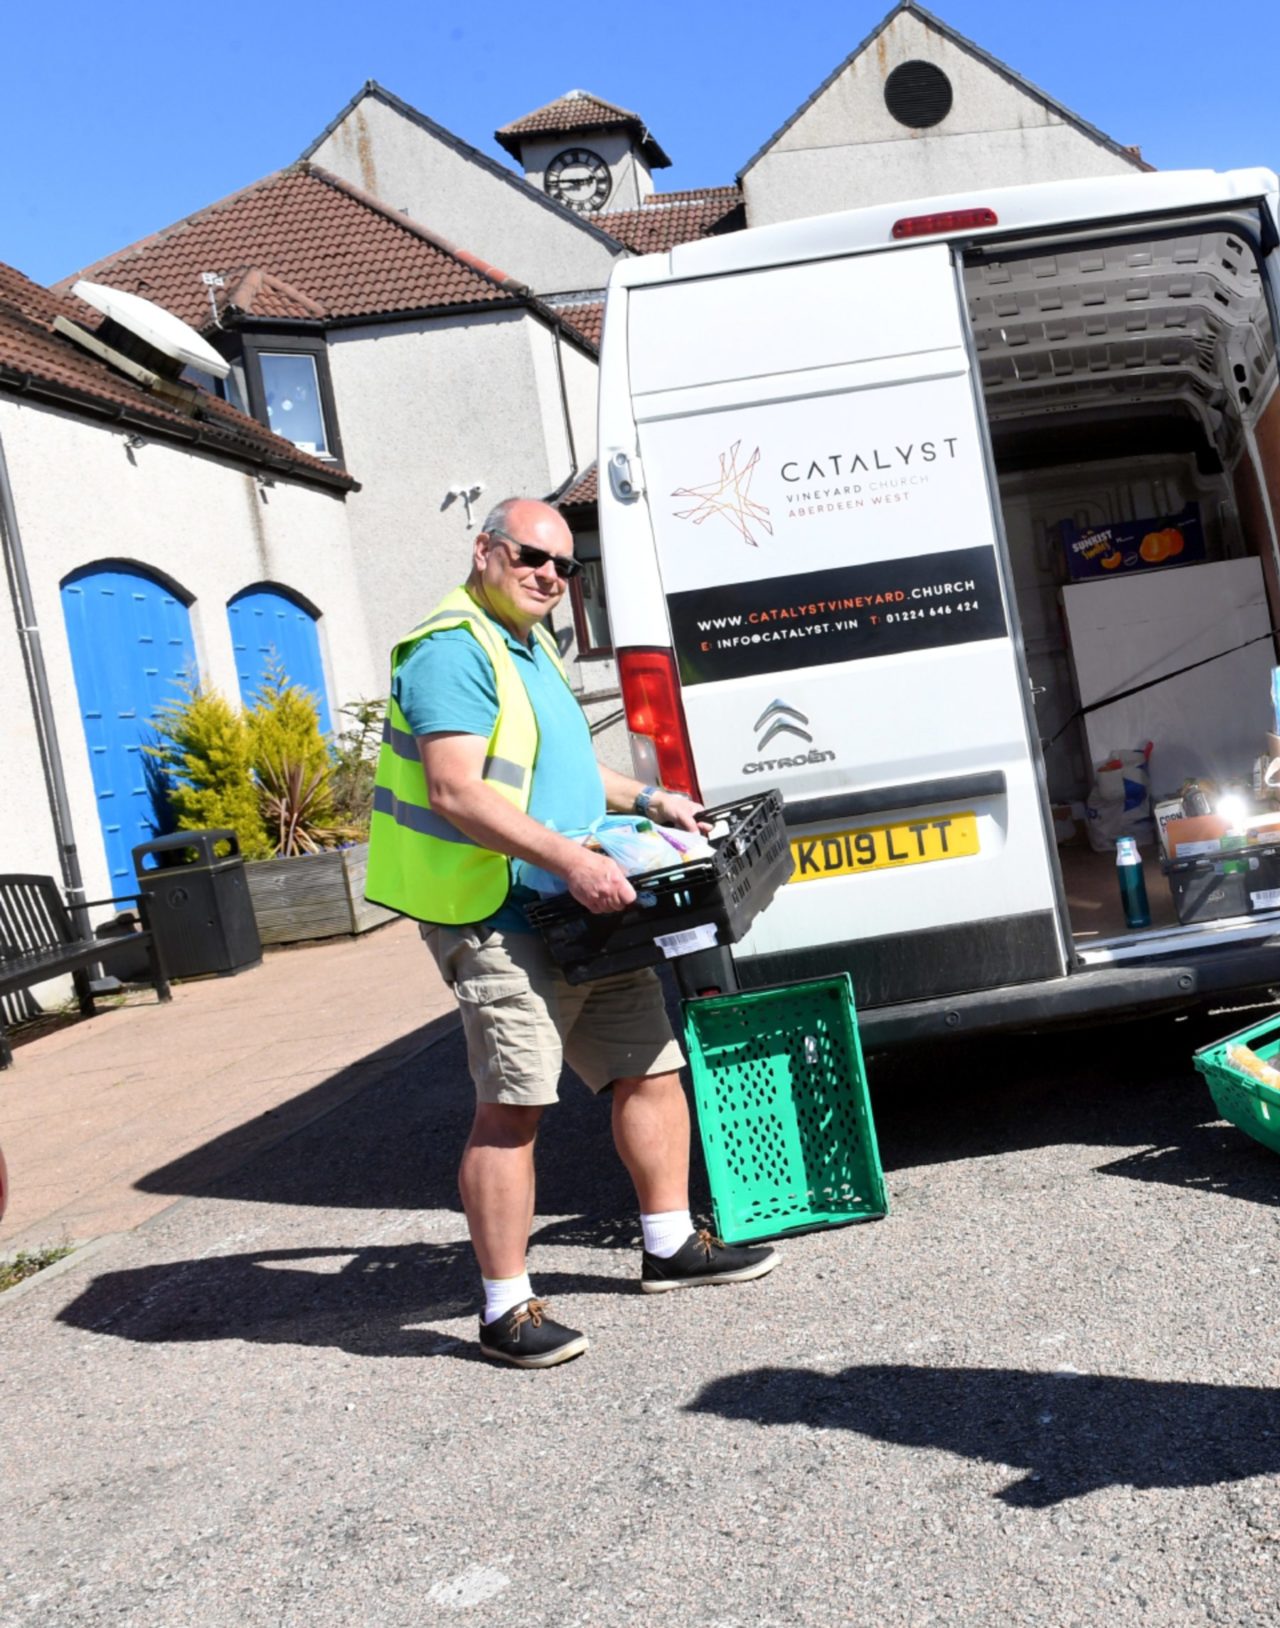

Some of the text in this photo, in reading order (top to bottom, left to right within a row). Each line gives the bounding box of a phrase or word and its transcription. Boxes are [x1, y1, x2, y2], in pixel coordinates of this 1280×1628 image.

[780, 438, 958, 482] CATALYST
[786, 475, 930, 503] VINEYARD CHURCH
[788, 492, 911, 518] ABERDEEN WEST
[1071, 529, 1113, 553] SUNKIST
[696, 579, 976, 632] WWW.CATALYSTVINEYARD.CHURCH
[716, 618, 859, 650] INFO@CATALYST.VIN
[885, 607, 925, 624] 01224
[929, 603, 952, 617] 646
[956, 600, 980, 614] 424
[798, 820, 953, 875] KD19 LTT
